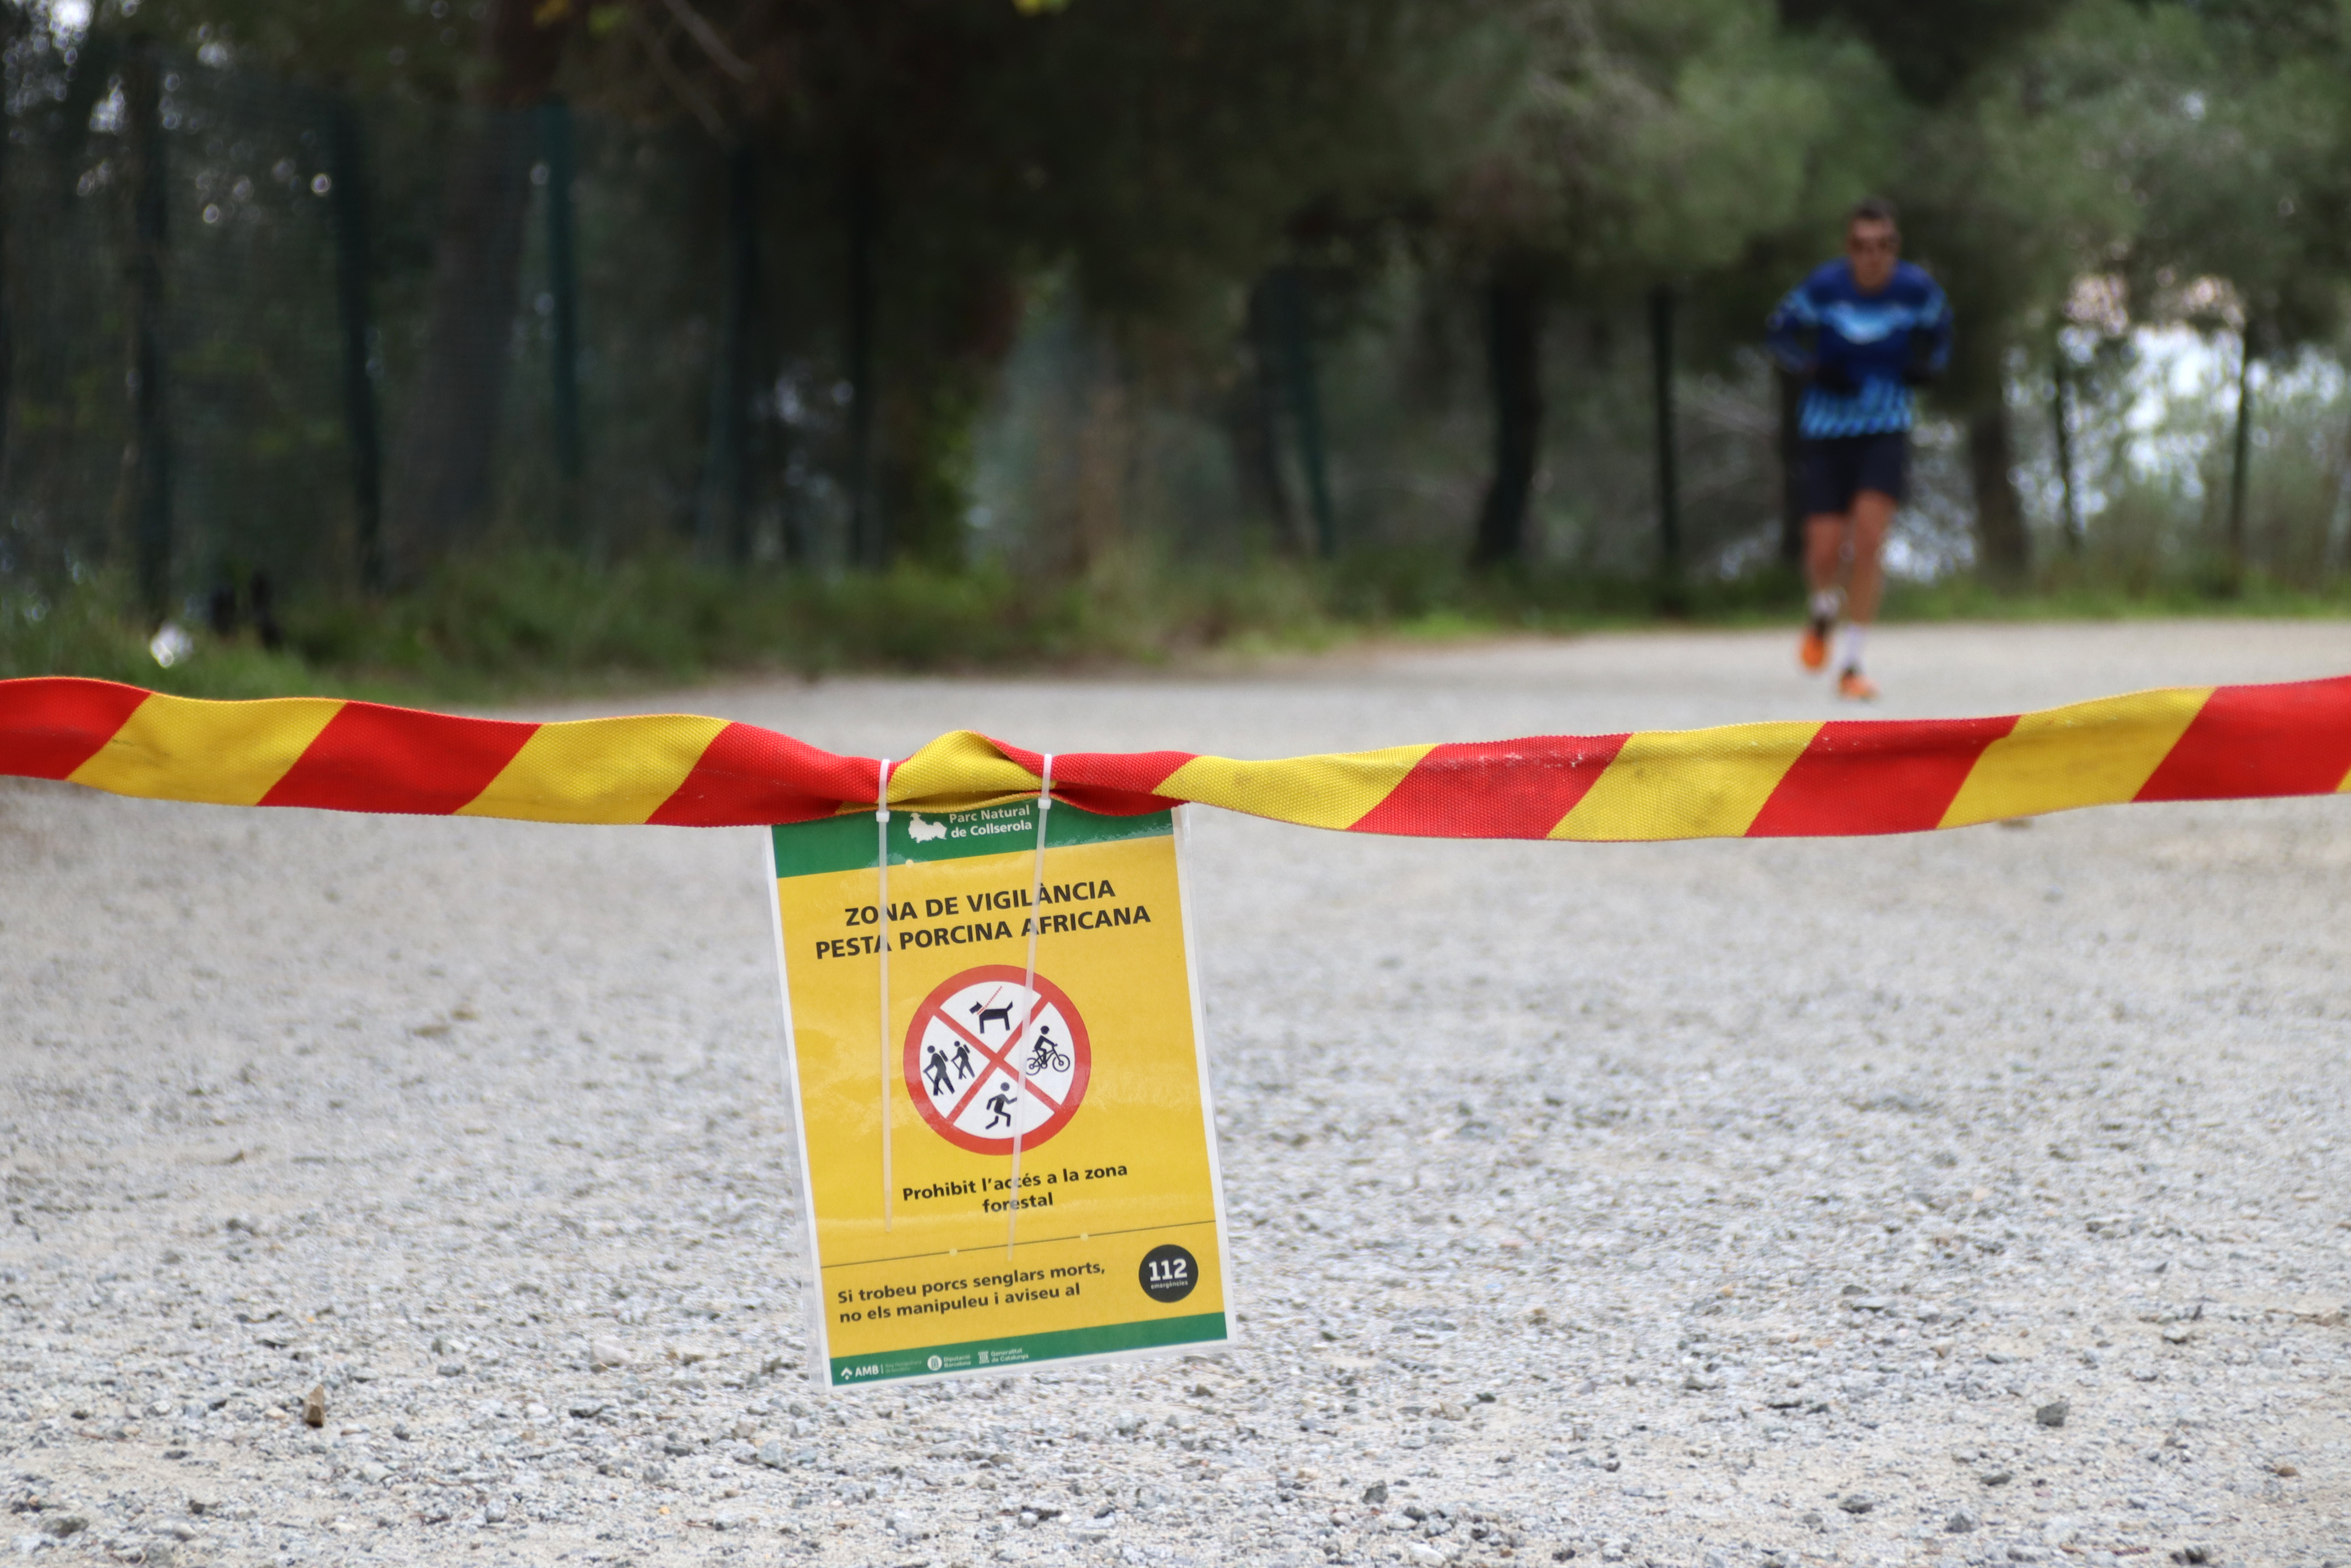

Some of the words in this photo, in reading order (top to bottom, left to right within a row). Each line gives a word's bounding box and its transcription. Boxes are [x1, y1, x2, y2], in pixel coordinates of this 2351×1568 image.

[949, 813, 977, 823] Parc
[980, 805, 1030, 820] Natural
[951, 827, 967, 838] de
[970, 819, 1032, 835] Collserola
[845, 902, 918, 926] ZONA
[926, 897, 959, 917] DE
[966, 879, 1116, 913] VIGILÀNCIA
[816, 935, 892, 960] PESTA
[900, 921, 1013, 950] PORCINA
[1021, 905, 1151, 937] AFRICANA
[903, 1180, 976, 1201] Prohibit
[1047, 1173, 1057, 1184] a
[1063, 1168, 1079, 1182] la
[1084, 1165, 1128, 1180] zona
[982, 1192, 1053, 1213] forestal
[1149, 1258, 1188, 1281] 112
[837, 1290, 853, 1303] Si
[859, 1284, 917, 1301] trobeu
[922, 1279, 968, 1297] porcs
[973, 1269, 1045, 1291] senglars
[1050, 1261, 1106, 1278] morts,
[1150, 1280, 1189, 1290] emergències
[840, 1310, 862, 1323] no
[867, 1304, 891, 1319] els
[896, 1296, 989, 1316] manipuleu
[994, 1292, 999, 1305] i
[1004, 1288, 1059, 1304] aviseu
[1065, 1283, 1080, 1297] al
[991, 1348, 1023, 1357] Generalitat
[1000, 1354, 1029, 1362] Catalunya
[855, 1364, 879, 1377] AMB
